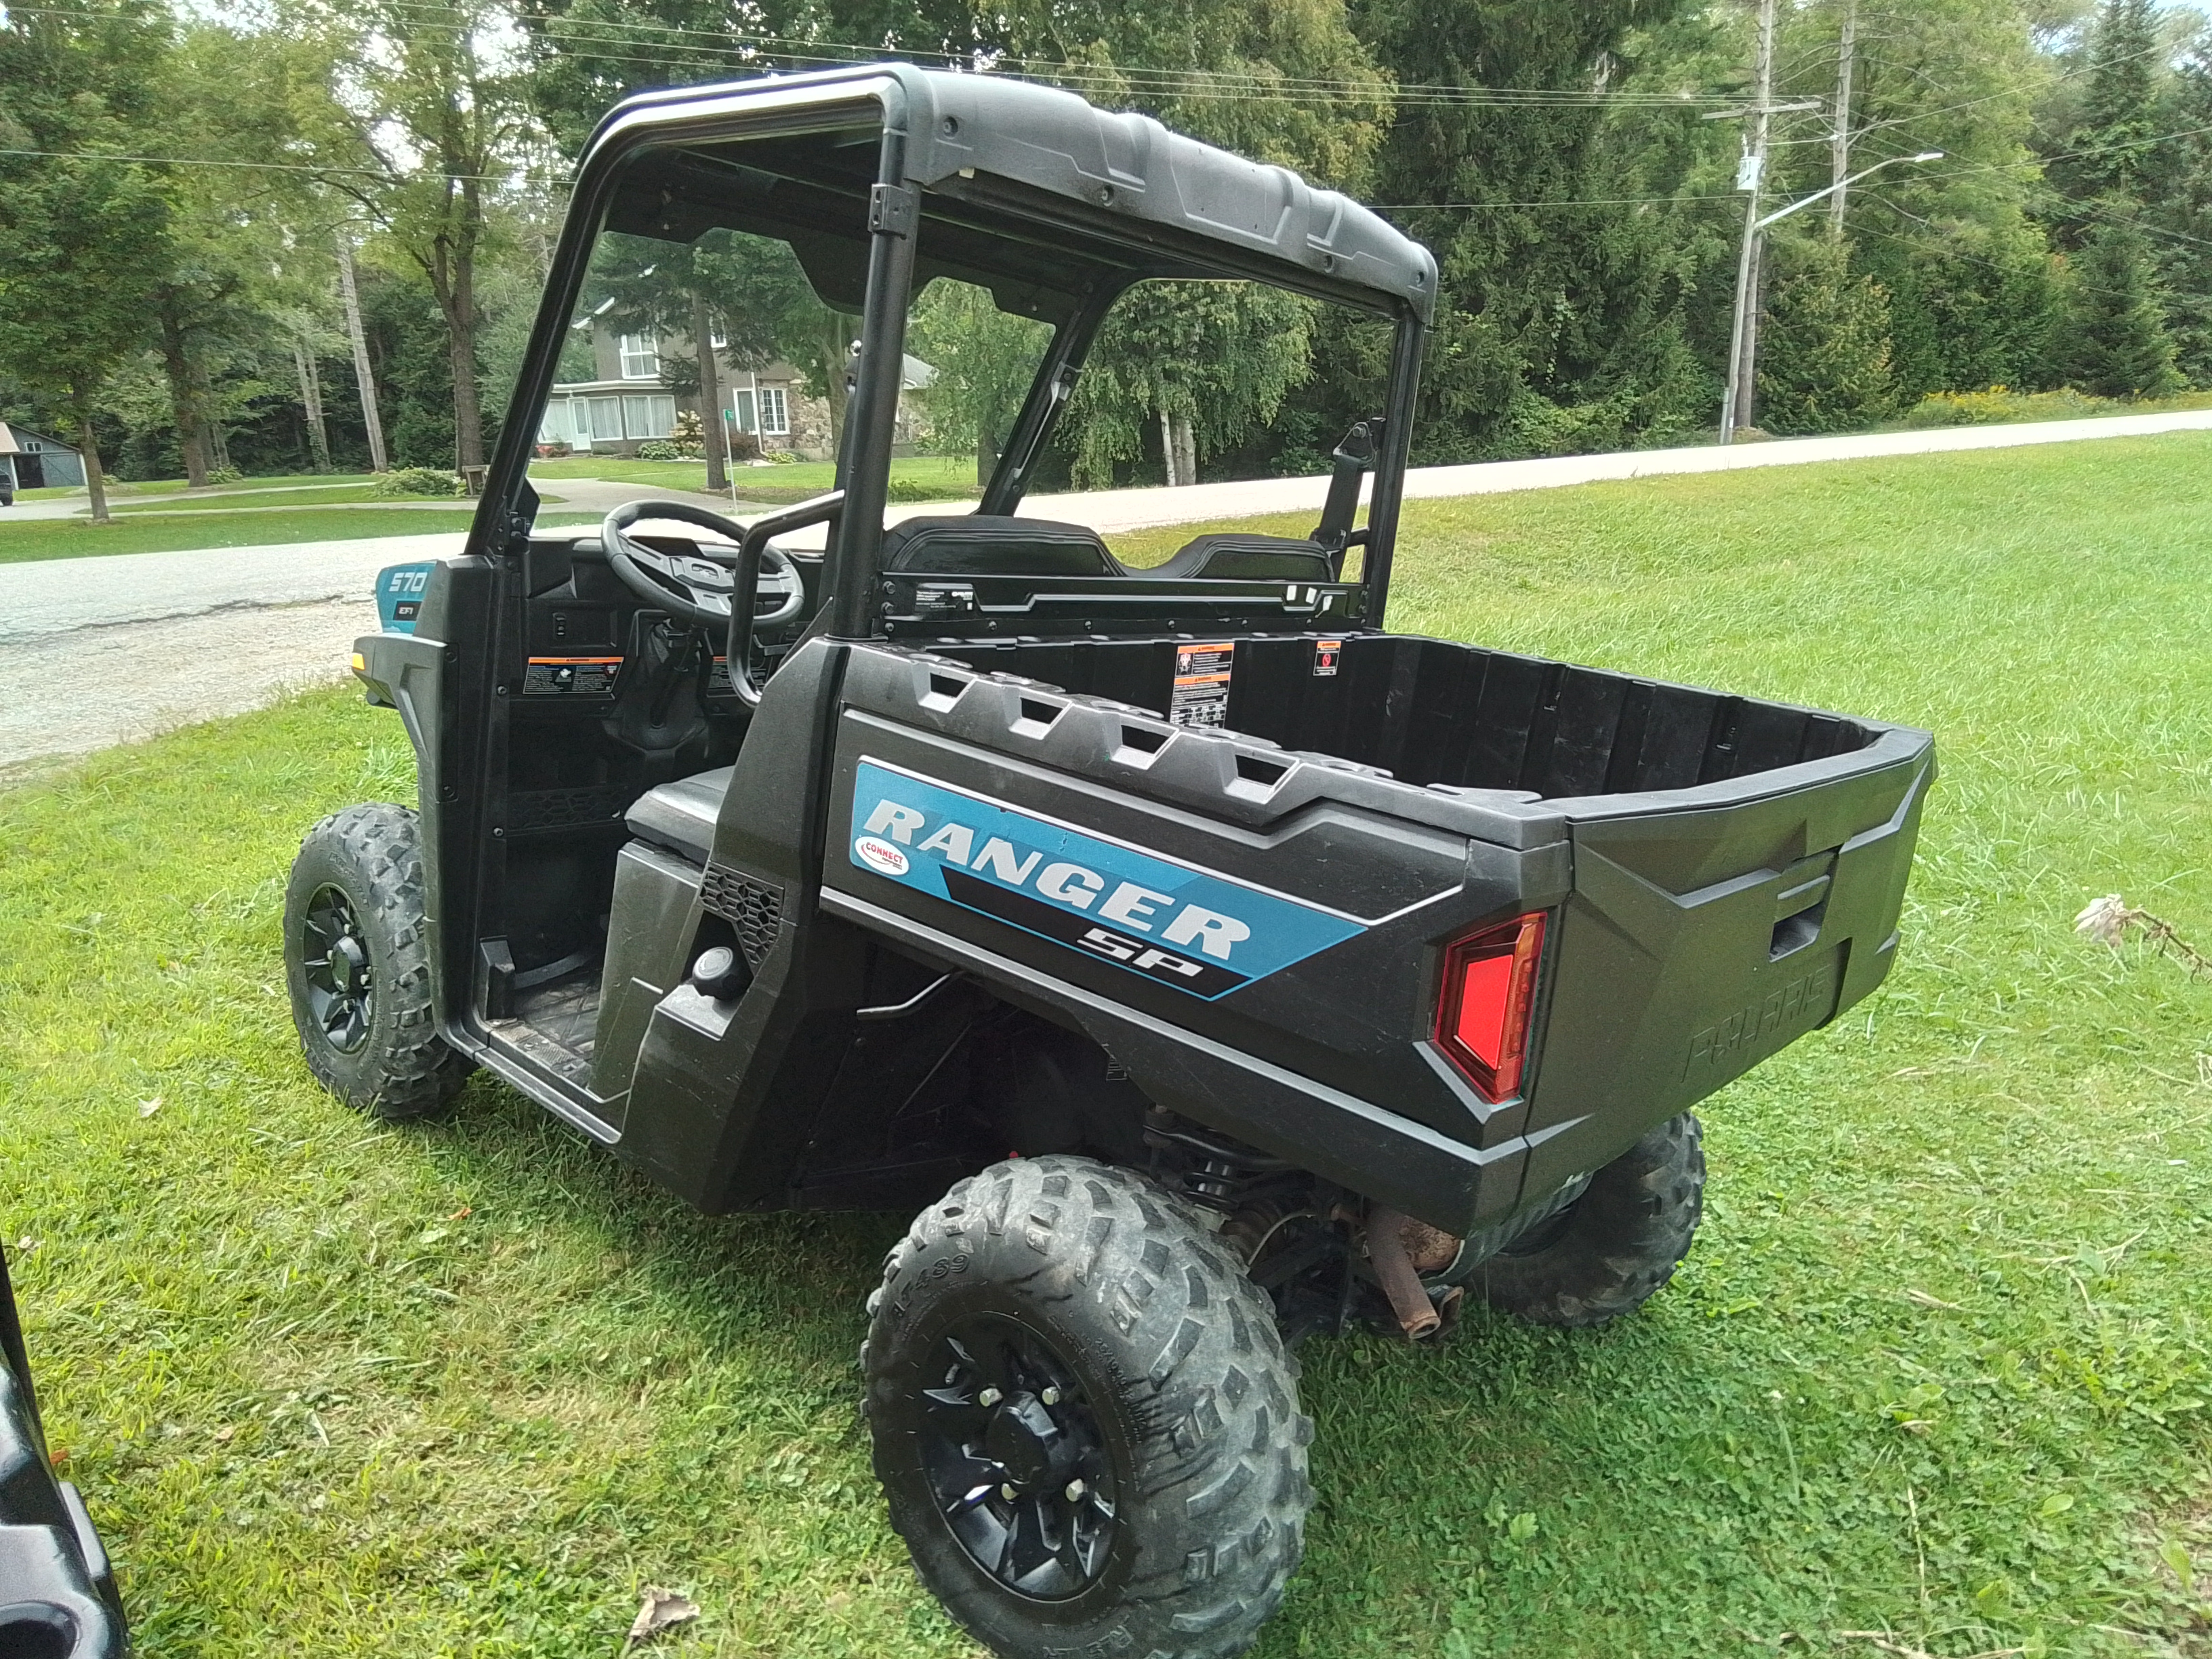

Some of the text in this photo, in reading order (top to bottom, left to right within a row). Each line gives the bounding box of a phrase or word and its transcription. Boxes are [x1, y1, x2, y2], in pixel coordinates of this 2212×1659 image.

[388, 571, 428, 592] 570
[865, 842, 903, 864] CONNECT
[863, 798, 1251, 961] RANGER
[1076, 927, 1204, 977] SP
[1680, 964, 1831, 1084] POLARIS
